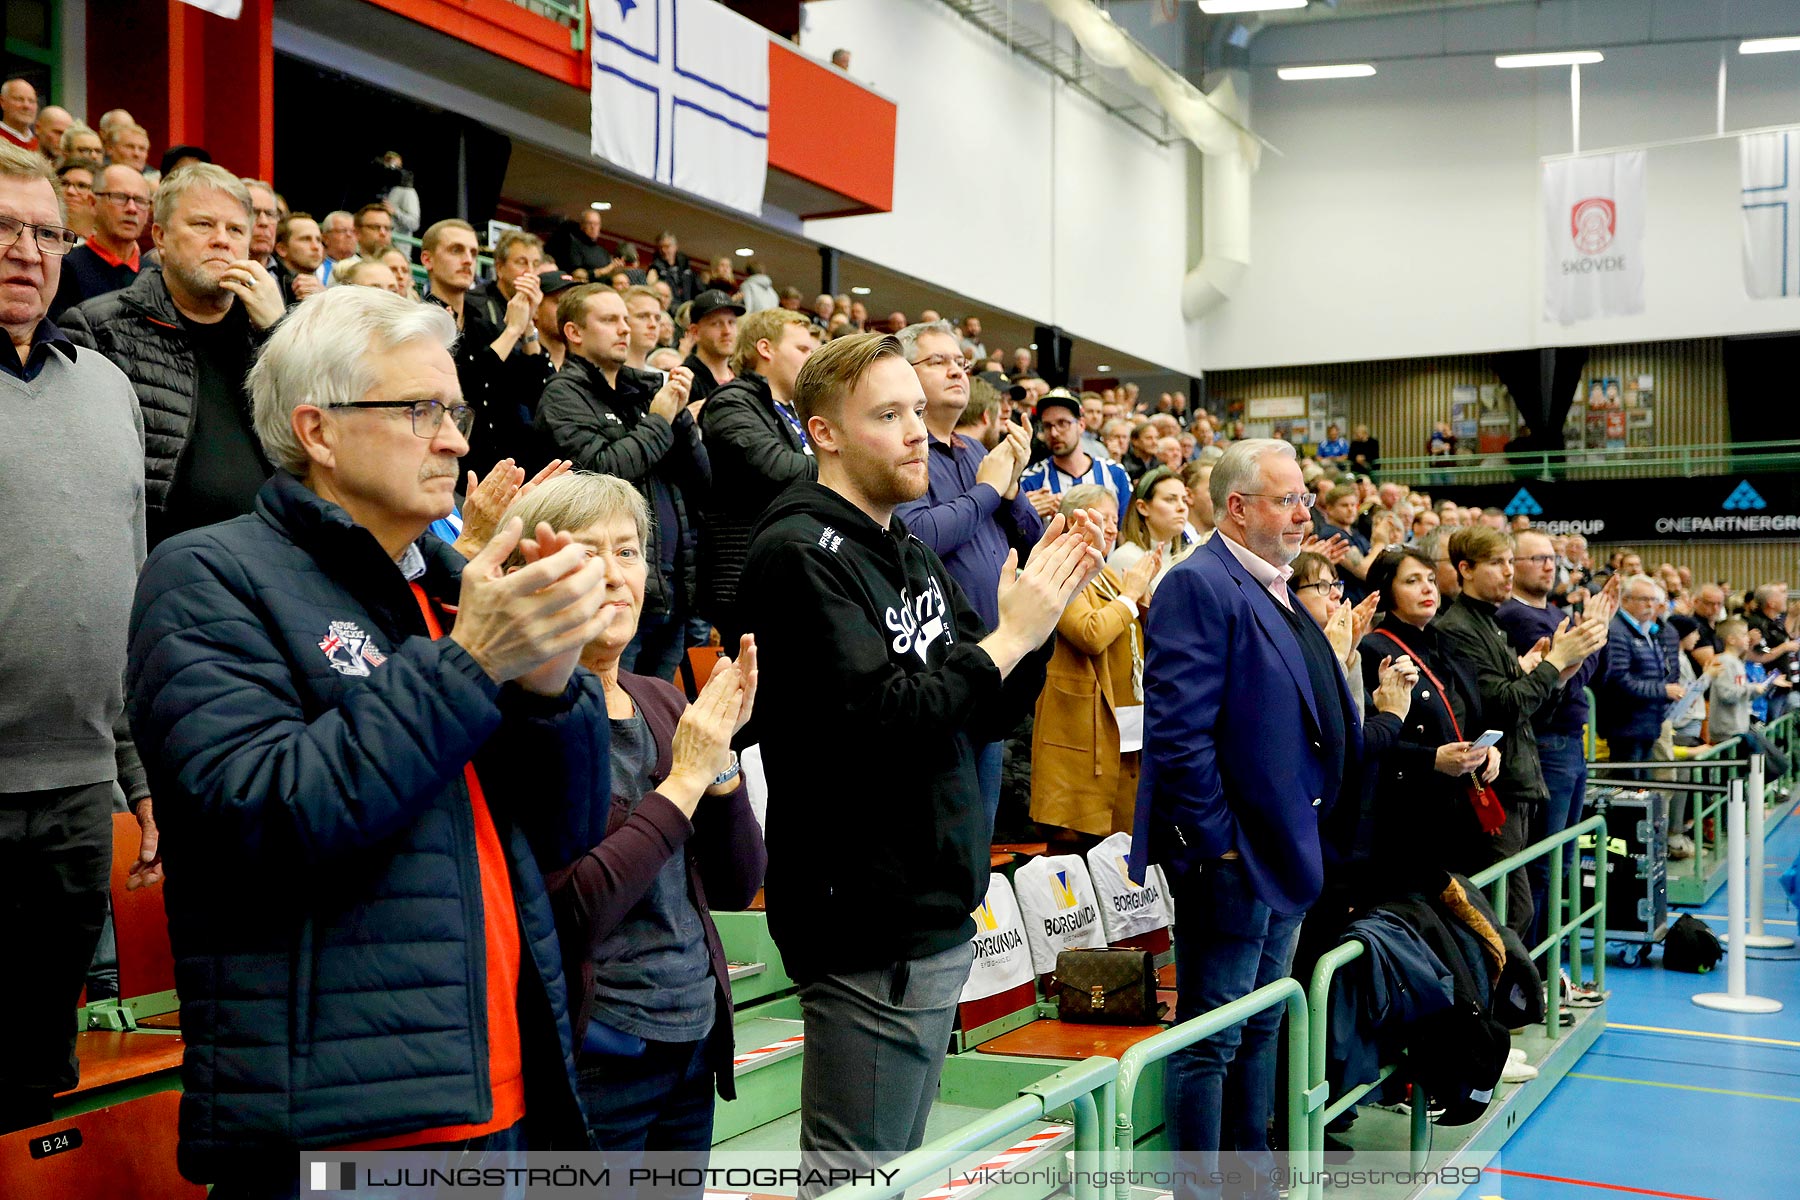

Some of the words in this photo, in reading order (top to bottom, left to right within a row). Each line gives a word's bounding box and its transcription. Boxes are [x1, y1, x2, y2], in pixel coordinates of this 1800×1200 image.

[1044, 904, 1096, 937] BORGUNDA
[971, 928, 1023, 960] ORGUNDA
[42, 1140, 52, 1153] B
[54, 1135, 69, 1149] 24
